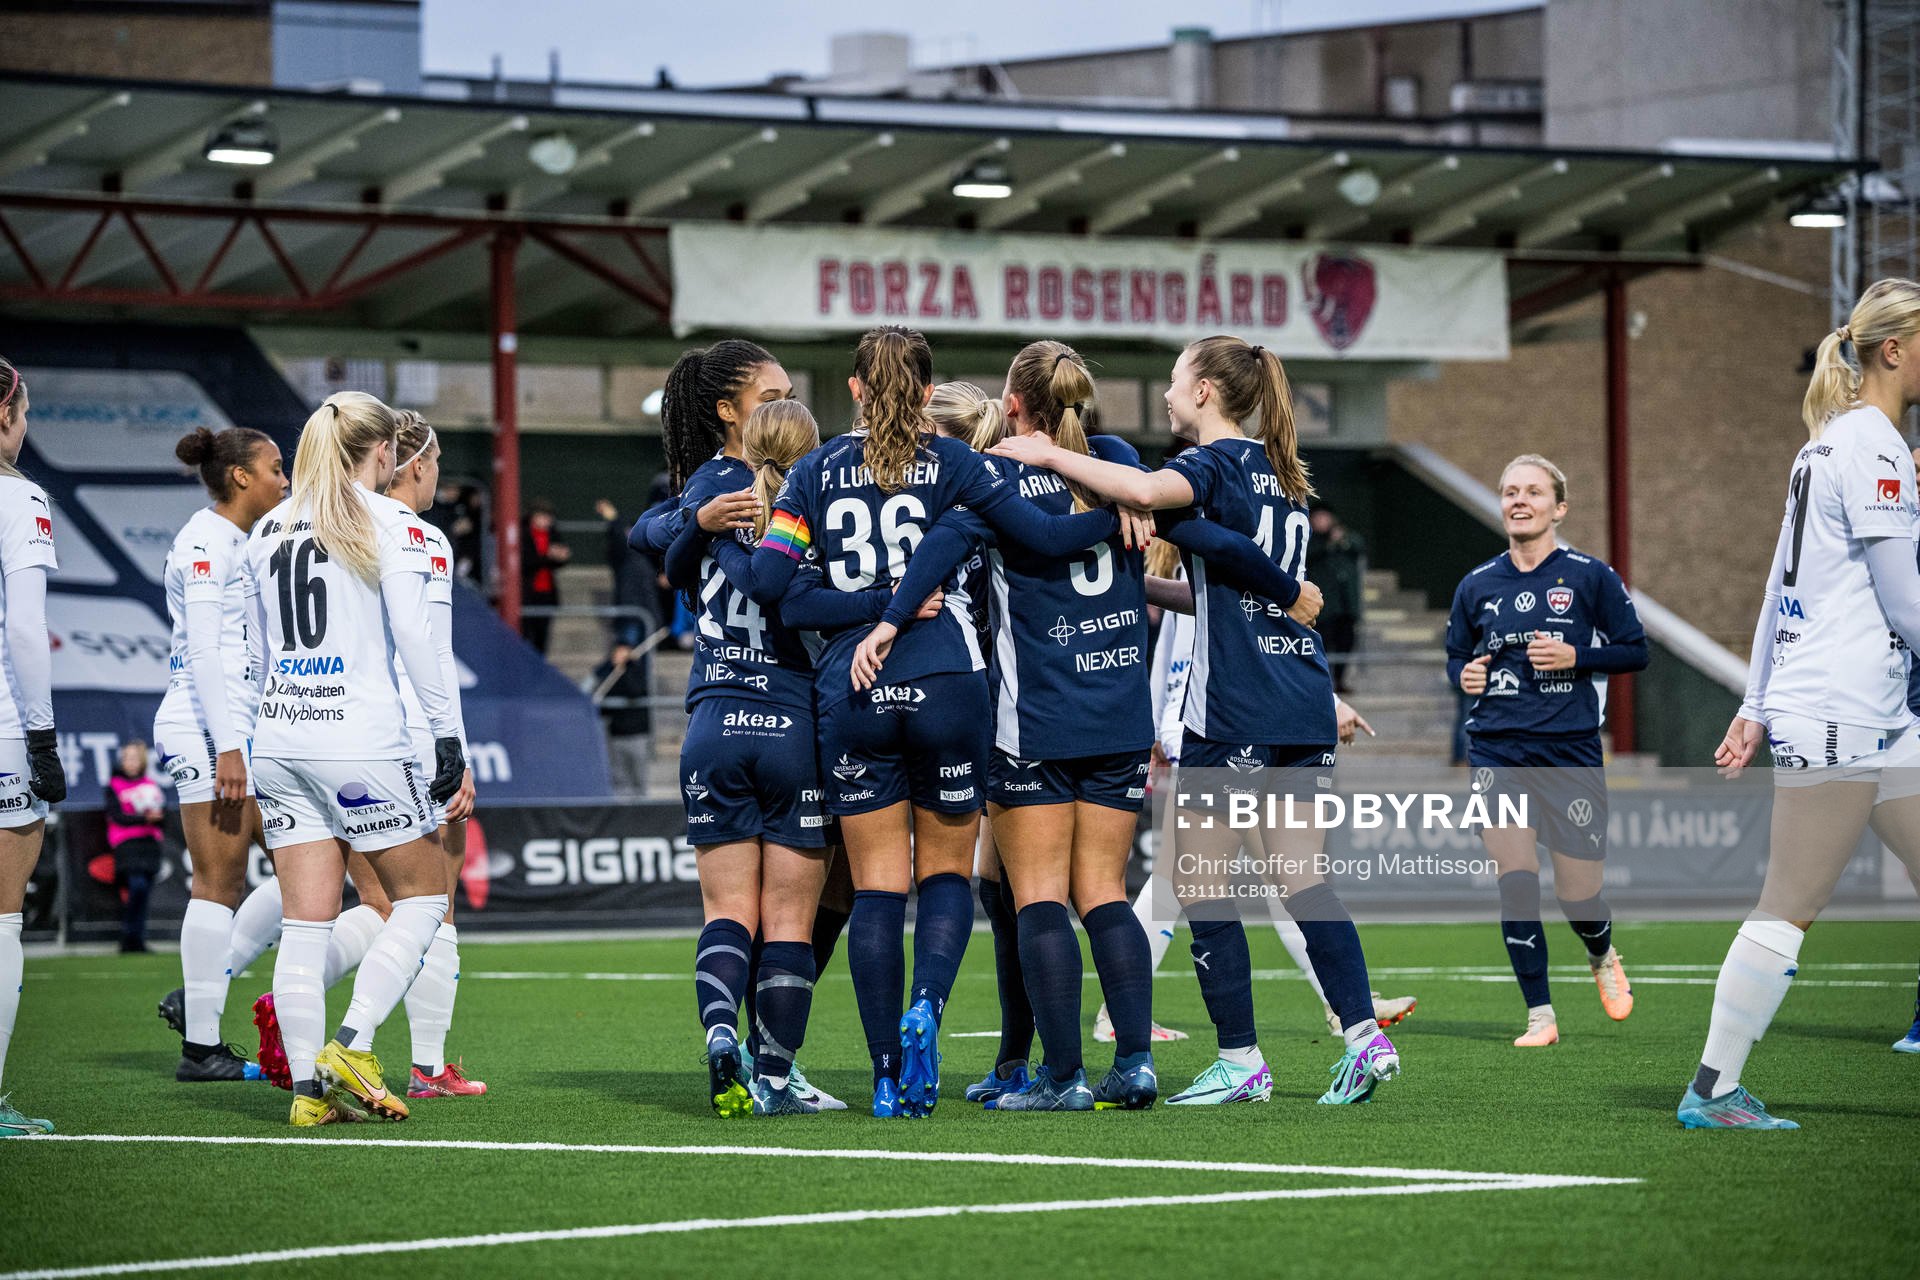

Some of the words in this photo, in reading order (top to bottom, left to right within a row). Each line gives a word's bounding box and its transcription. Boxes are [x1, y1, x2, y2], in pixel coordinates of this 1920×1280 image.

[818, 258, 979, 319] FORZA
[1004, 252, 1288, 327] ROSENGÅRD
[822, 470, 834, 491] P.
[840, 463, 940, 489] LUNREN
[1019, 473, 1067, 498] ARNA
[825, 494, 928, 593] 36
[270, 537, 329, 652] 16
[698, 556, 767, 651] 24
[1080, 608, 1139, 635] SIGM
[1533, 670, 1578, 681] MELLBY
[1540, 682, 1573, 694] GÅRD
[280, 703, 345, 726] Nybloms
[723, 710, 778, 729] akea
[940, 762, 972, 778] RWE
[1004, 781, 1043, 792] Scandic
[801, 789, 825, 802] RW
[839, 789, 876, 802] Scandic
[942, 791, 964, 800] MKB
[346, 804, 381, 818] INCITA
[383, 803, 396, 812] AB
[688, 812, 715, 824] andic
[803, 817, 822, 826] MKB
